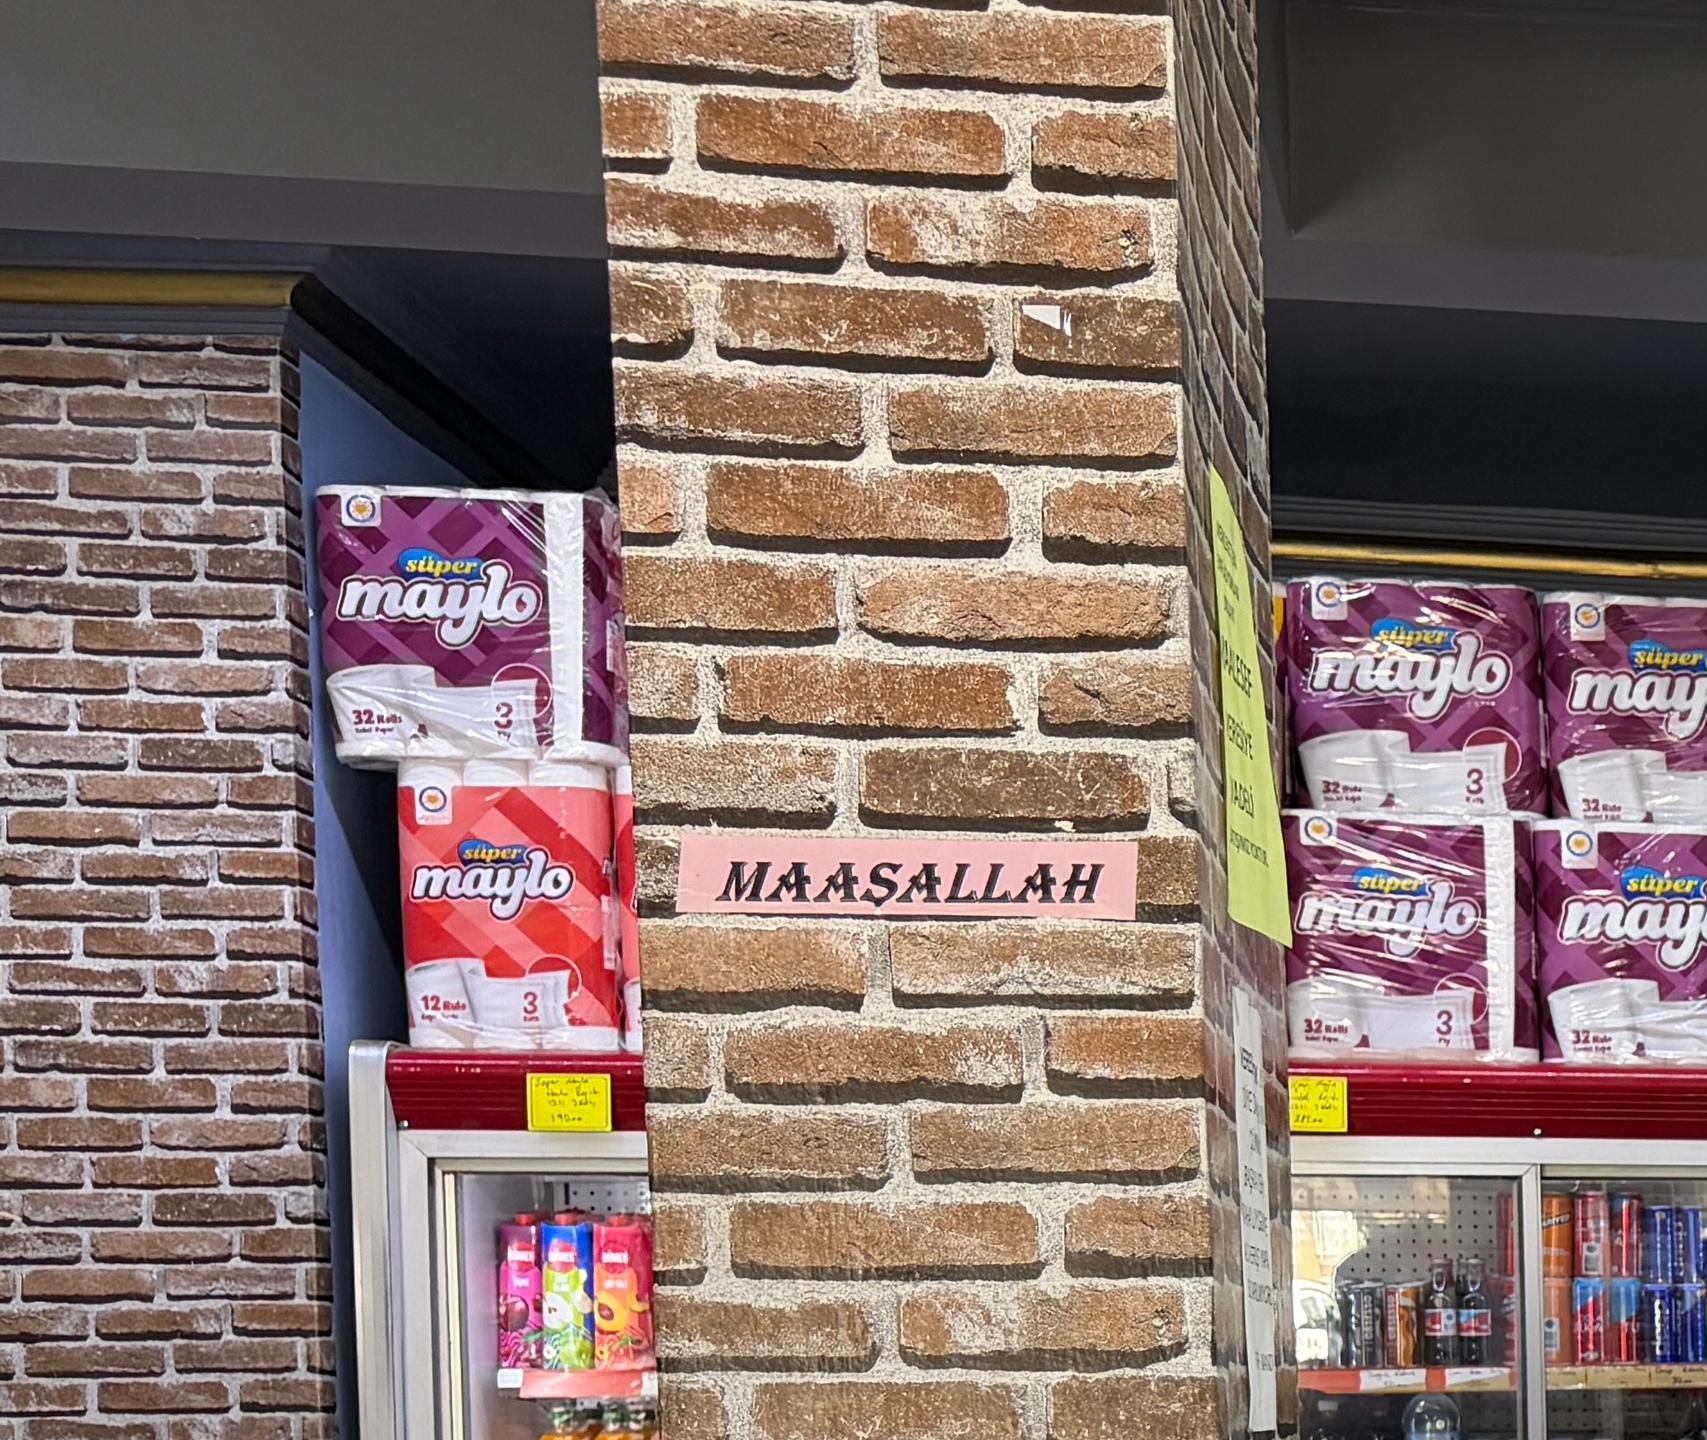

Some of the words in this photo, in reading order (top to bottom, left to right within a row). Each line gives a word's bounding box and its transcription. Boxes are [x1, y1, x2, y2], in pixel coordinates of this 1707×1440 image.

[406, 556, 477, 576] süper
[339, 559, 540, 648] maylo
[1377, 628, 1448, 648] süper
[1635, 649, 1703, 668] süper
[1312, 634, 1511, 718] maylo
[352, 710, 374, 725] 32
[495, 702, 513, 730] 3
[463, 844, 522, 863] süper
[412, 850, 573, 919] maylo
[1361, 876, 1423, 894] süper
[1628, 877, 1698, 897] süper
[1299, 882, 1481, 956] maylo
[422, 996, 441, 1011] 12
[523, 992, 537, 1014] 3
[1436, 1010, 1452, 1035] 3
